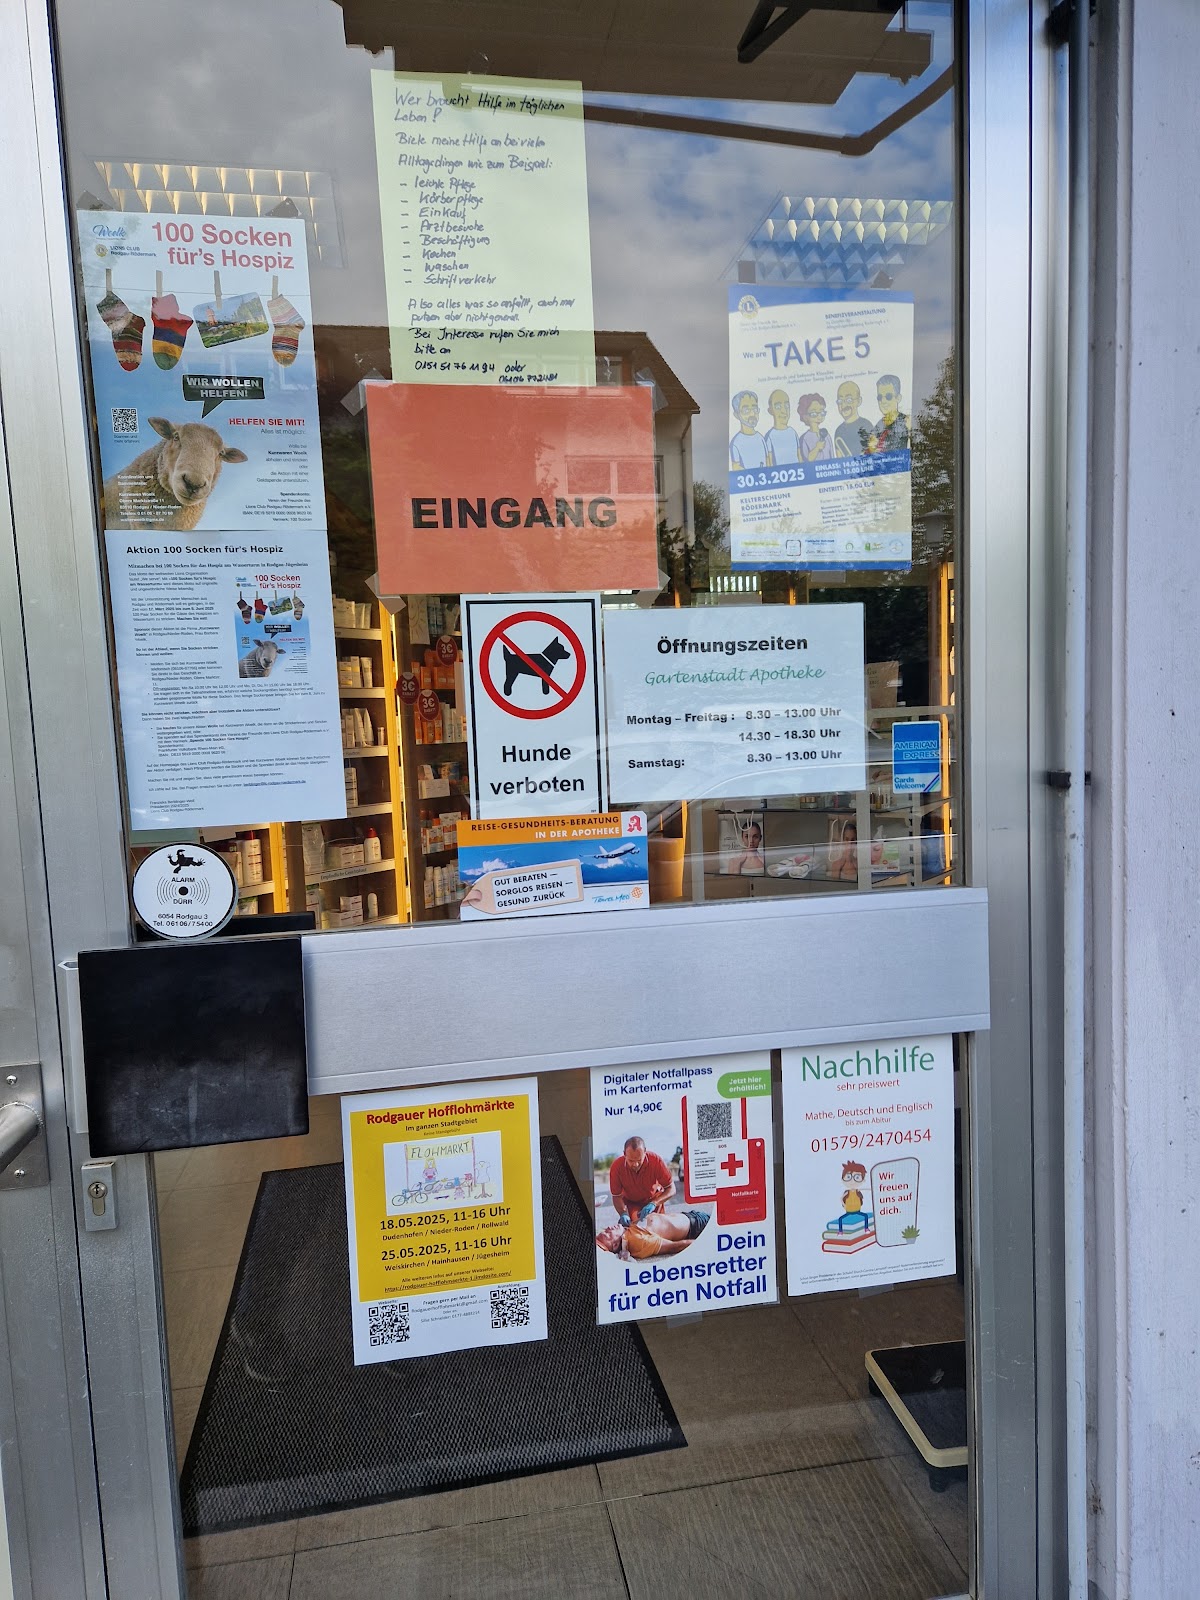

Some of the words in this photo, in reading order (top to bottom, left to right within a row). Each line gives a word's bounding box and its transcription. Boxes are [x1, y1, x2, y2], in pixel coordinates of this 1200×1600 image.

[394, 88, 420, 106] Wer
[478, 92, 502, 114] Hilfe
[506, 97, 516, 109] im
[415, 175, 444, 190] leichte
[449, 177, 476, 194] Pflege
[151, 222, 194, 243] 100
[202, 223, 292, 248] Socken
[167, 247, 215, 266] für's
[222, 250, 294, 272] Hospiz
[825, 308, 886, 320] BENEFIZVERANSTALTUNG
[408, 327, 431, 339] Bei
[490, 329, 514, 343] rufen
[517, 327, 535, 338] Sie
[537, 326, 560, 337] mich
[764, 335, 846, 368] TAKE
[854, 333, 871, 359] 5
[186, 377, 210, 387] WIR
[212, 378, 260, 389] WOLLEN
[200, 389, 248, 398] HELFEN!
[229, 418, 265, 426] HELFEN
[268, 418, 283, 426] SIE
[286, 418, 305, 427] MIT!
[815, 463, 841, 472] EINLASS:
[843, 460, 860, 468] 14.00
[860, 458, 873, 466] UHR
[816, 469, 842, 479] BEGINN:
[843, 467, 860, 475] 15.00
[861, 464, 875, 472] UHR
[737, 468, 805, 489] 30.3.2025
[740, 492, 791, 504] KELTERSCHEUNE
[411, 497, 617, 529] EINGANG
[741, 502, 782, 512] RÖDERMARK
[126, 546, 160, 554] Aktion
[163, 546, 182, 554] 100
[185, 545, 221, 554] Socken
[224, 545, 247, 553] für's
[250, 544, 284, 554] Hospiz
[270, 574, 301, 582] Socken
[277, 582, 302, 590] Hospiz
[441, 644, 453, 654] 3€
[657, 636, 809, 657] Öffnungszeiten
[645, 668, 748, 686] Gartenstadt
[749, 664, 827, 685] Apotheke
[402, 680, 415, 691] 3€
[422, 698, 435, 708] 3€
[626, 714, 672, 727] Montag
[685, 711, 728, 725] Freitag
[745, 709, 772, 720] 8.30
[785, 708, 816, 719] 13.00
[820, 707, 842, 717] Uhr
[739, 731, 771, 742] 14.30
[784, 729, 816, 740] 18.30
[820, 728, 841, 739] Uhr
[502, 744, 572, 763] Hunde
[894, 741, 937, 750] AMERICAN
[628, 758, 685, 771] Samstag:
[747, 752, 773, 764] 8.30
[785, 751, 817, 762] 13.00
[820, 749, 842, 760] Uhr
[903, 750, 940, 760] EXPRESS
[490, 776, 585, 795] verboten
[471, 816, 619, 832] REISE-GESUNDHEITS-BERATUNG
[535, 831, 546, 839] IN
[550, 830, 568, 838] DER
[571, 827, 620, 837] APOTHEKE
[494, 878, 511, 887] GUT
[513, 872, 548, 885] BERATEN
[495, 886, 534, 897] SORGLOS
[536, 880, 563, 891] REISEN
[173, 897, 193, 905] DÜRR
[497, 897, 531, 908] GESUND
[533, 891, 566, 902] ZURÜCK
[802, 1045, 935, 1082] Nachhilfe
[603, 1072, 649, 1086] Digitaler
[652, 1066, 713, 1080] Notfallpass
[604, 1087, 617, 1097] im
[620, 1080, 693, 1096] Kartenformat
[729, 1083, 766, 1093] erhältlich!
[836, 1082, 856, 1092] sehr
[858, 1079, 900, 1092] preiswert
[366, 1109, 425, 1124] Rodgauer
[428, 1100, 515, 1119] Hofflohmärkte
[604, 1106, 625, 1117] Nur
[628, 1101, 663, 1116] 14,90€
[805, 1111, 835, 1121] Mathe,
[837, 1106, 874, 1118] Deutsch
[876, 1104, 894, 1114] und
[896, 1102, 933, 1115] Englisch
[416, 1122, 439, 1132] ganzen
[440, 1117, 478, 1128] Stadtgebiet
[871, 1117, 892, 1125] Abitur
[811, 1128, 932, 1152] 01579/2470454
[411, 1141, 470, 1158] FLOHMARKT
[879, 1172, 895, 1181] Wir
[731, 1189, 759, 1198] Notfallkarte
[879, 1183, 909, 1192] freuen
[879, 1195, 896, 1204] uns
[898, 1192, 913, 1202] auf
[380, 1214, 450, 1230] 18.05.2025,
[453, 1209, 486, 1222] 11-16
[490, 1206, 511, 1217] Uhr
[879, 1206, 902, 1216] dich.
[382, 1231, 423, 1241] Dudenhofen
[430, 1223, 475, 1236] Nieder-Roden
[481, 1220, 509, 1229] Rollwald
[381, 1243, 451, 1261] 25.05.2025,
[455, 1238, 487, 1251] 11-16
[491, 1235, 512, 1246] Uhr
[717, 1231, 766, 1252] Dein
[384, 1261, 426, 1272] Weiskirchen
[431, 1255, 470, 1265] Hainhausen
[476, 1250, 510, 1260] Jügesheim
[625, 1255, 767, 1287] Lebensretter
[608, 1292, 641, 1312] für
[647, 1287, 689, 1307] den
[696, 1274, 767, 1301] Notfall
